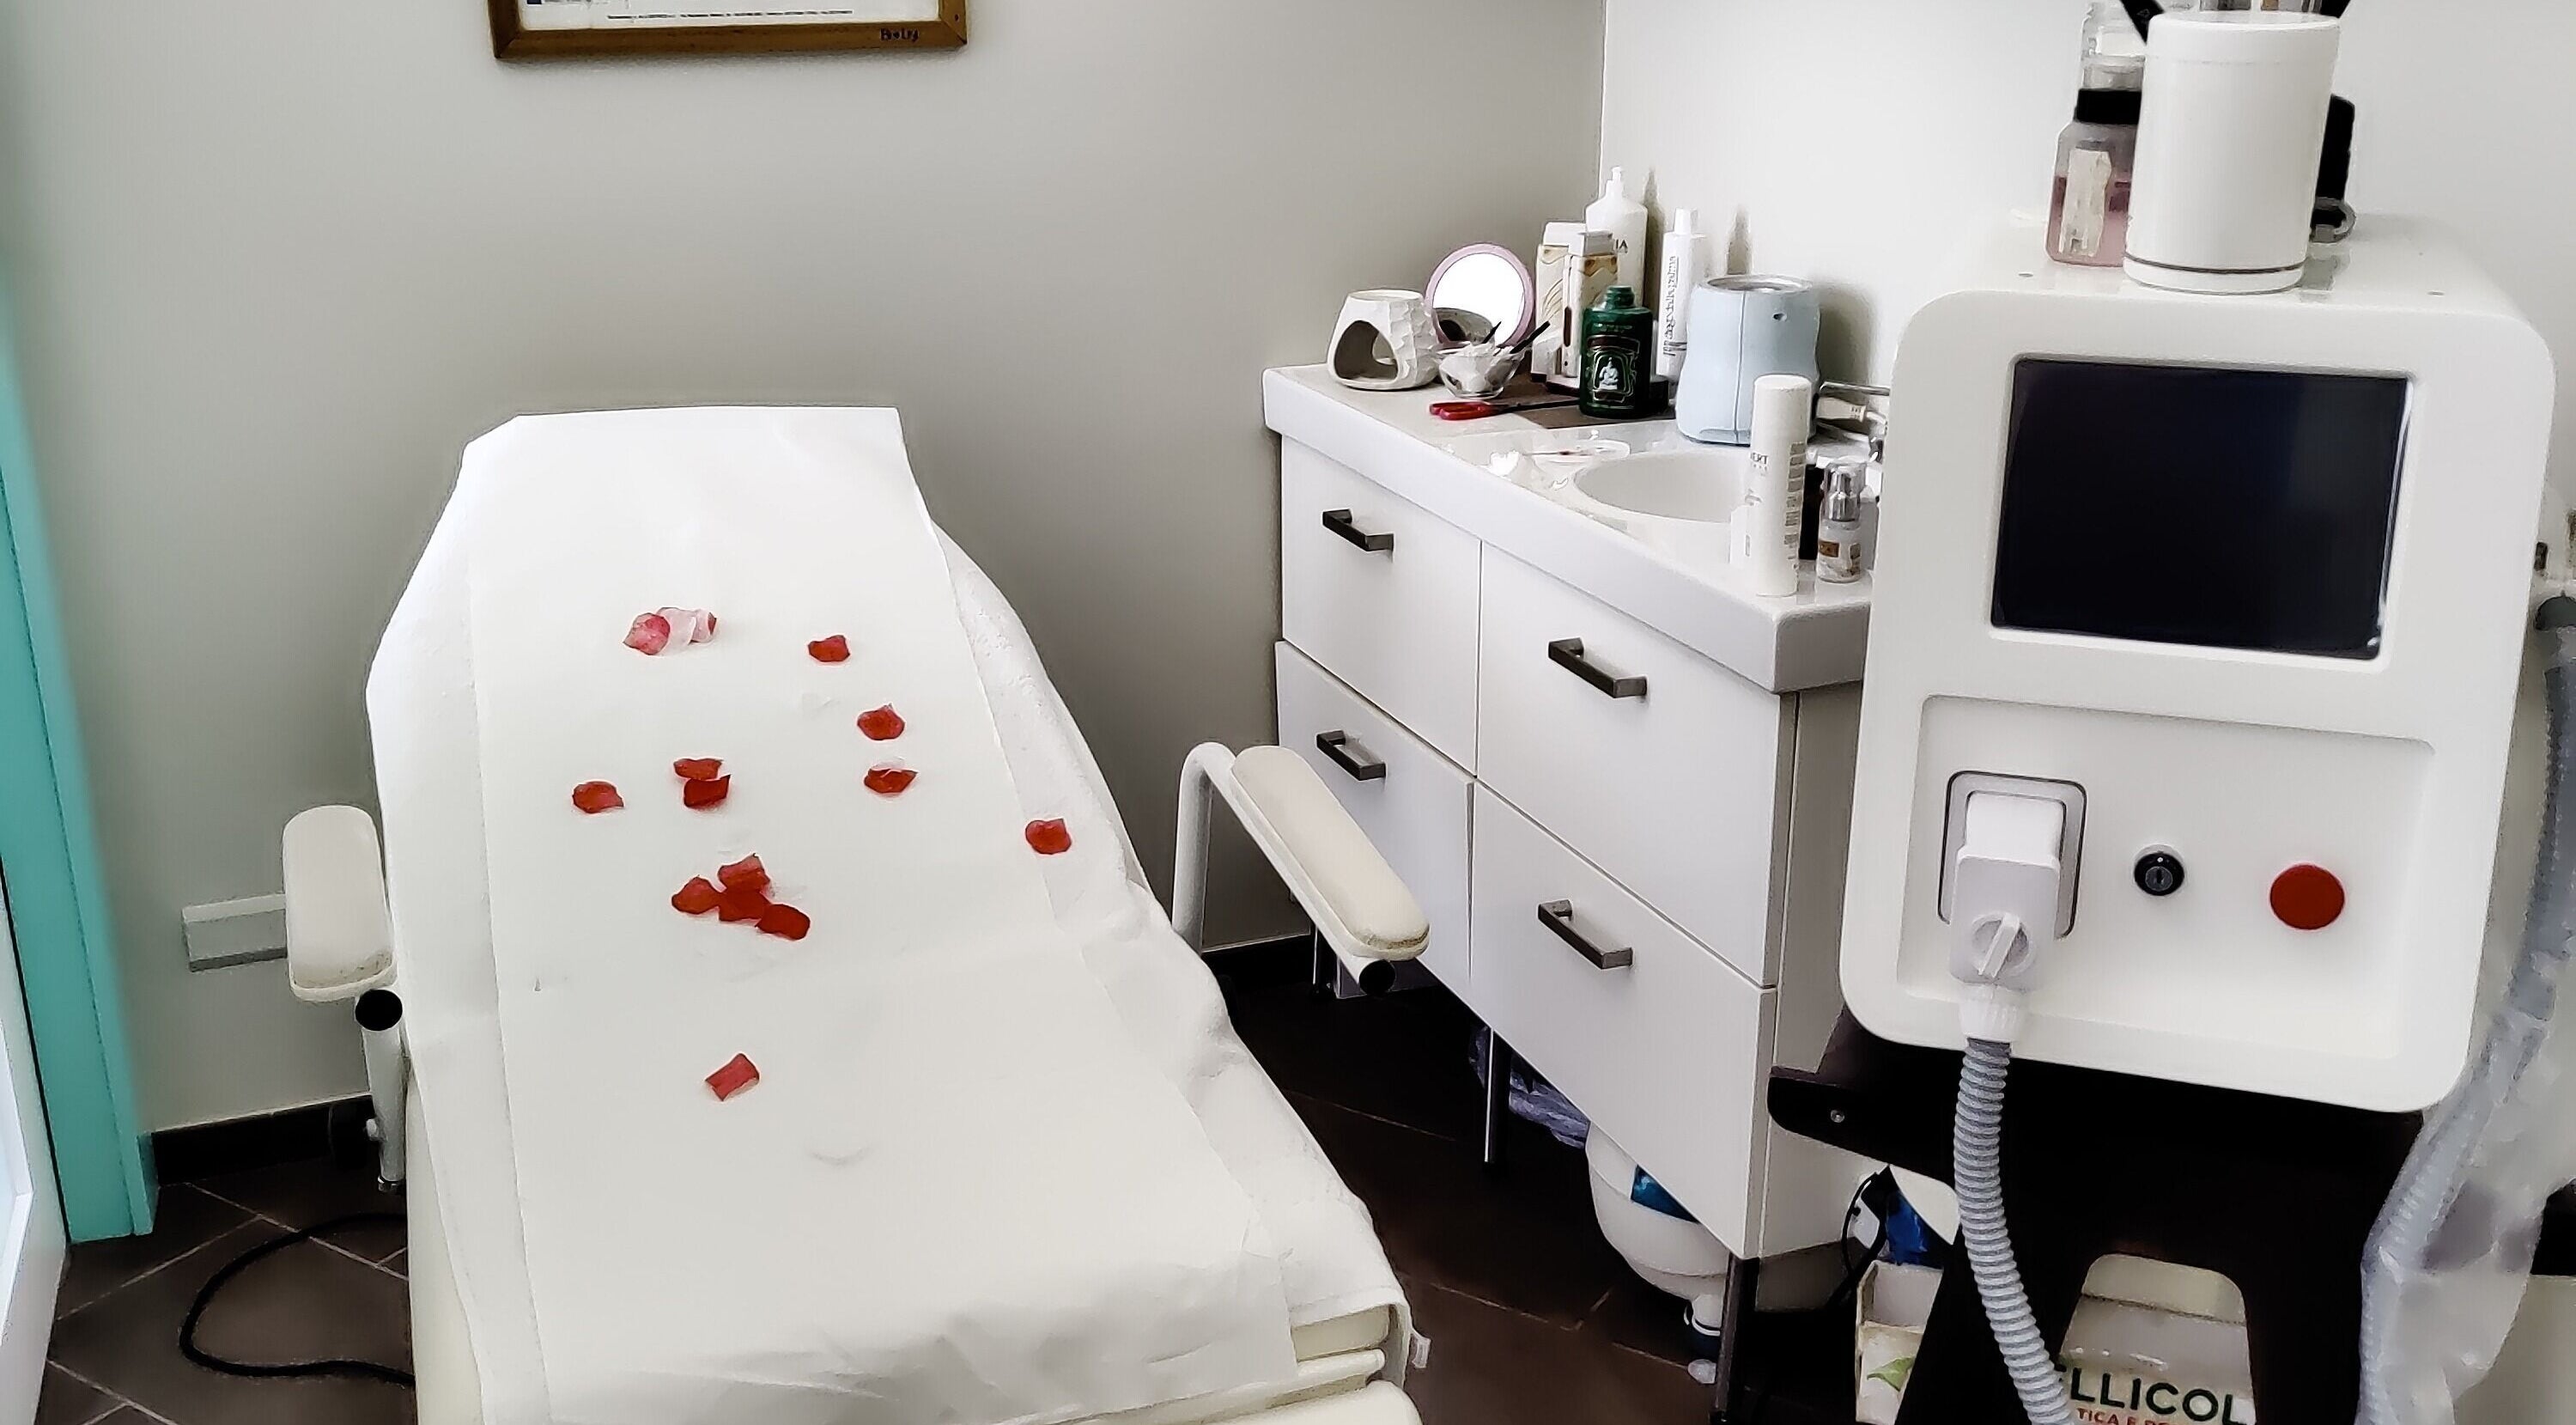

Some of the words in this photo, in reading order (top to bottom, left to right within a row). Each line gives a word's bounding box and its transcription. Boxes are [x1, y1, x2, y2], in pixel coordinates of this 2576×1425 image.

[1615, 239, 1628, 253] IA
[2055, 1364, 2249, 1425] LLICOL
[2076, 1408, 2119, 1425] TICA
